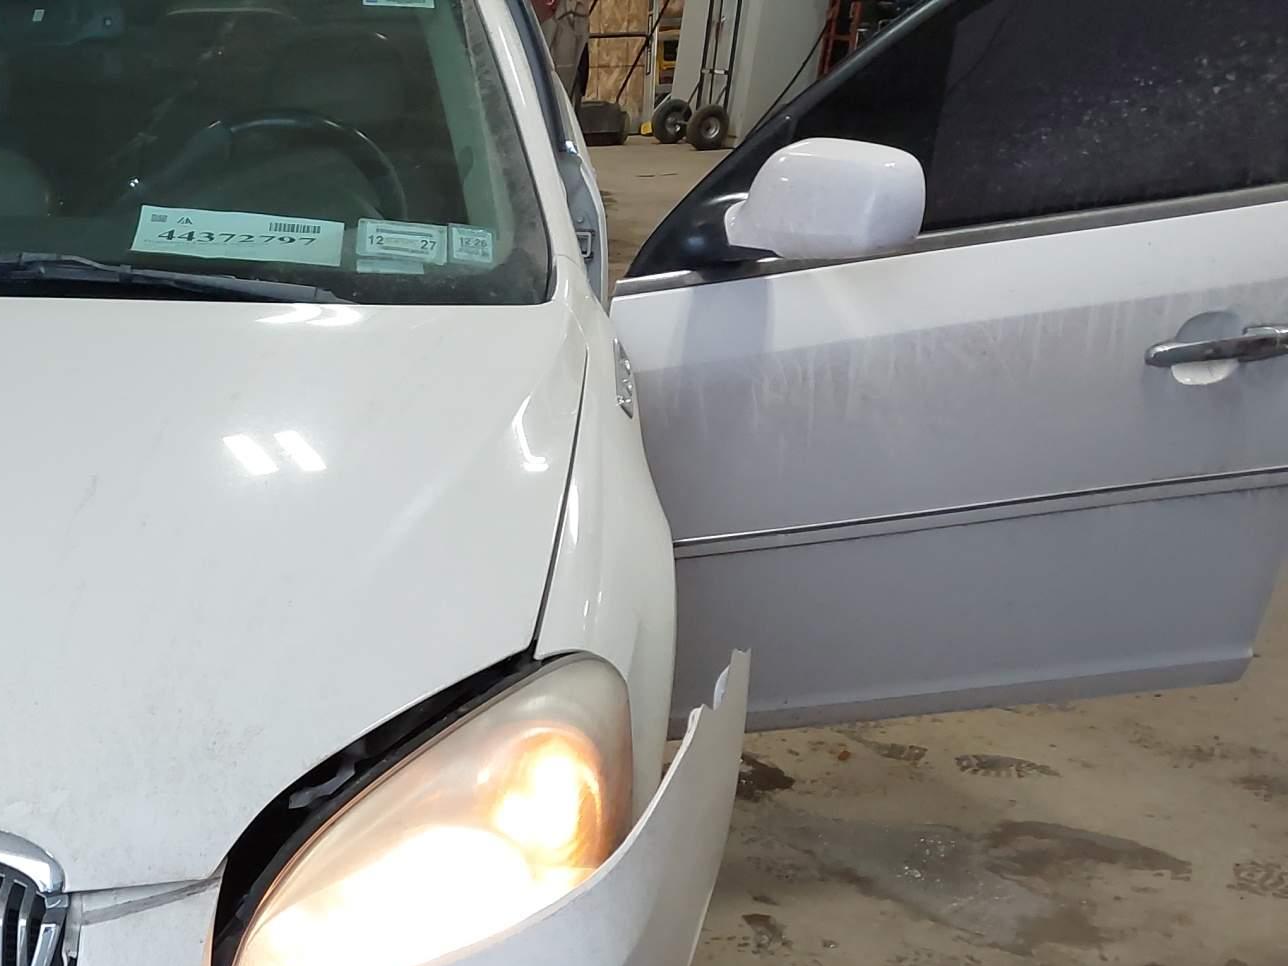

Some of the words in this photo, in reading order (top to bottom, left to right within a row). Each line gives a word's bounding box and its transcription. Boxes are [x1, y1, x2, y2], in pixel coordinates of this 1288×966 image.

[157, 229, 317, 246] 44372797
[368, 234, 385, 246] 12
[419, 239, 437, 251] 27
